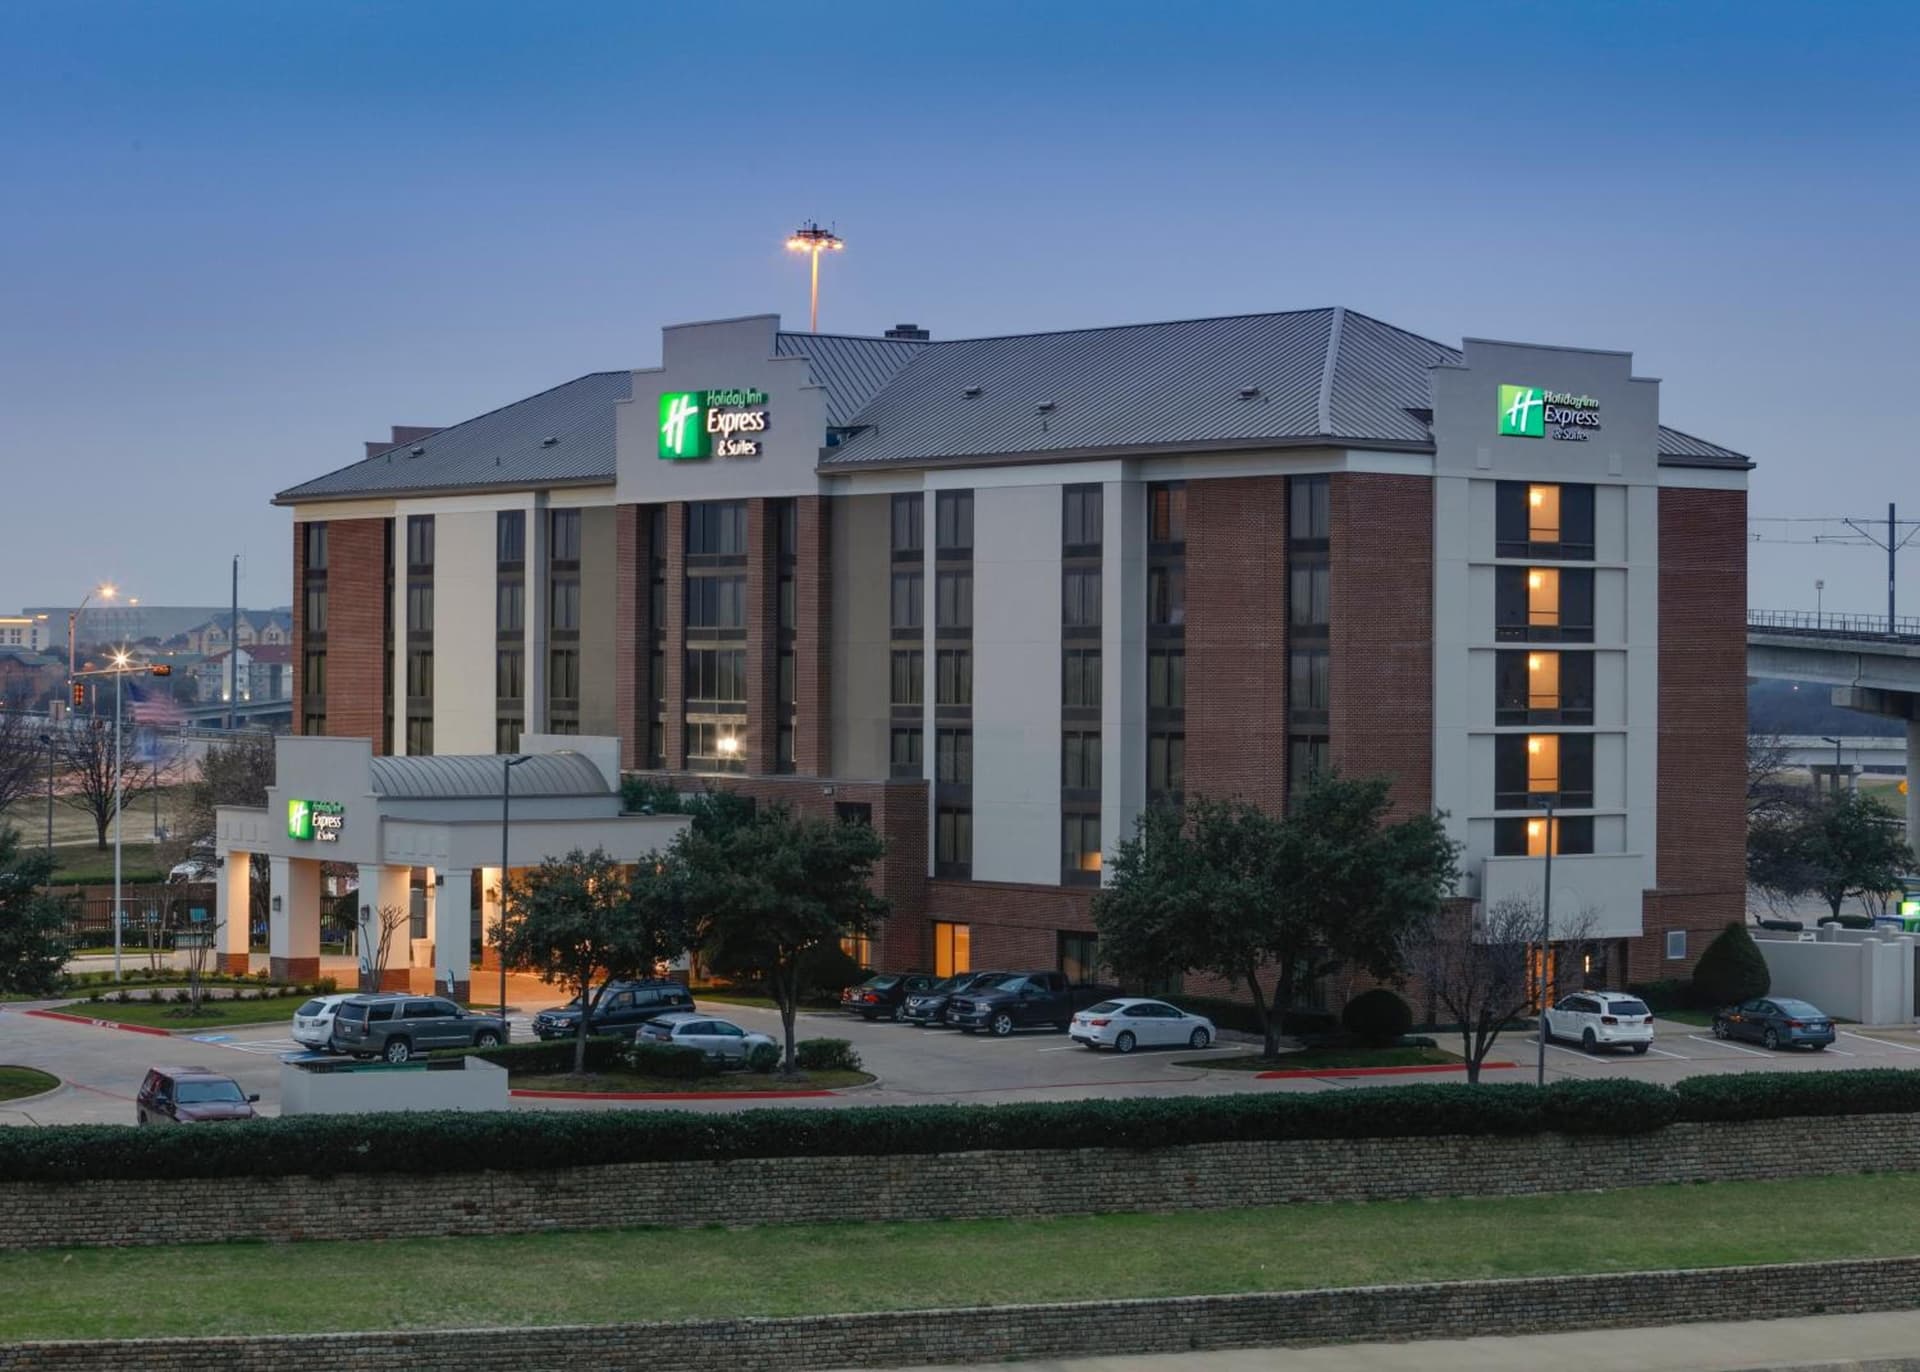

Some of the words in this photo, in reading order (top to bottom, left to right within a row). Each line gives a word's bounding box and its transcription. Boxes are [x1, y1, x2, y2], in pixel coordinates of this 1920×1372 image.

[707, 390, 745, 408] Holiday
[747, 388, 762, 404] Inn
[707, 408, 765, 438] Express
[1544, 405, 1599, 428] Express
[717, 441, 726, 456] &
[727, 440, 757, 456] Suites
[312, 812, 341, 830] Express
